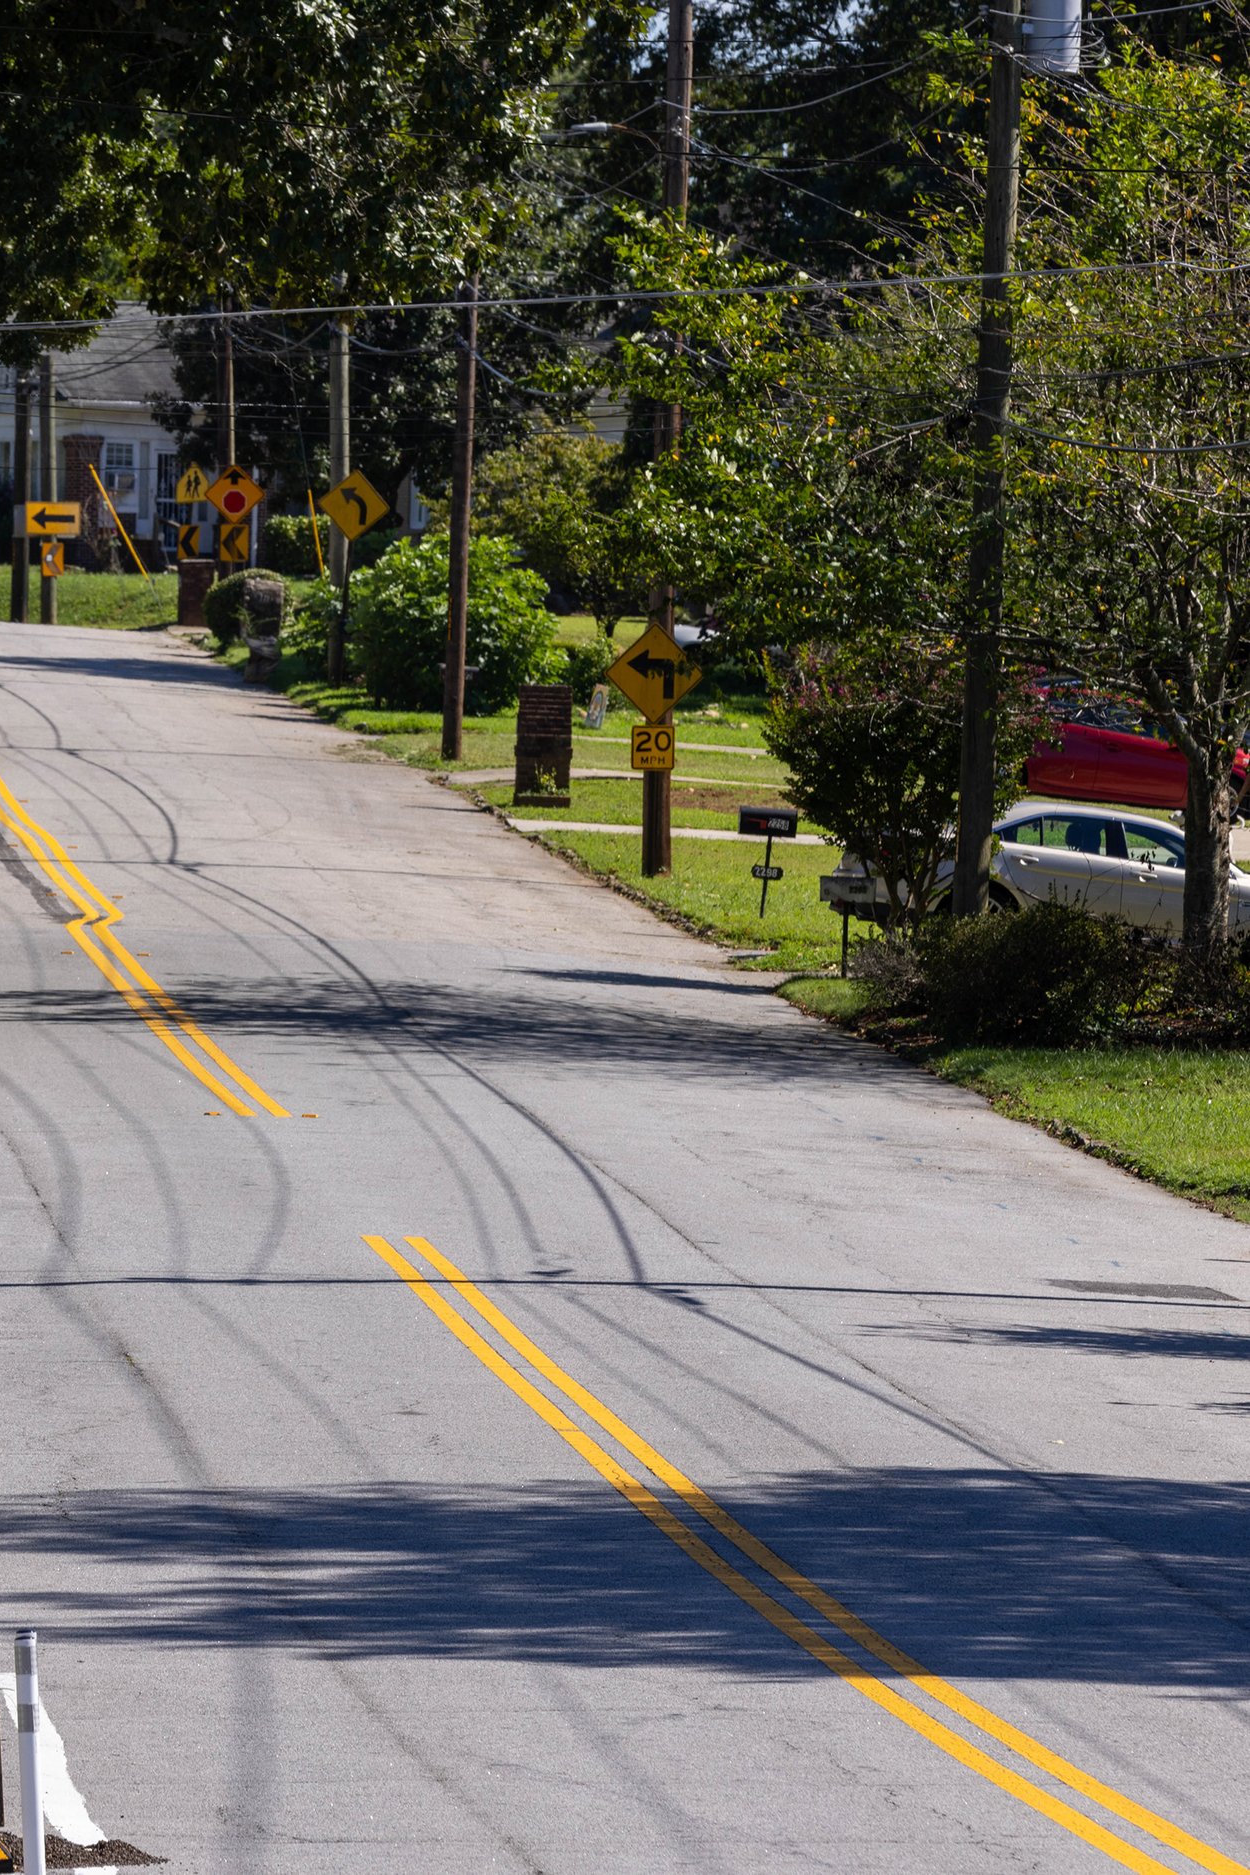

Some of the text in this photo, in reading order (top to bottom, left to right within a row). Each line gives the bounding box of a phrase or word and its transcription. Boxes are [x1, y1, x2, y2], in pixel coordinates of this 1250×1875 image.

[636, 731, 671, 752] 20
[640, 756, 665, 765] MPH
[754, 866, 778, 878] 2298
